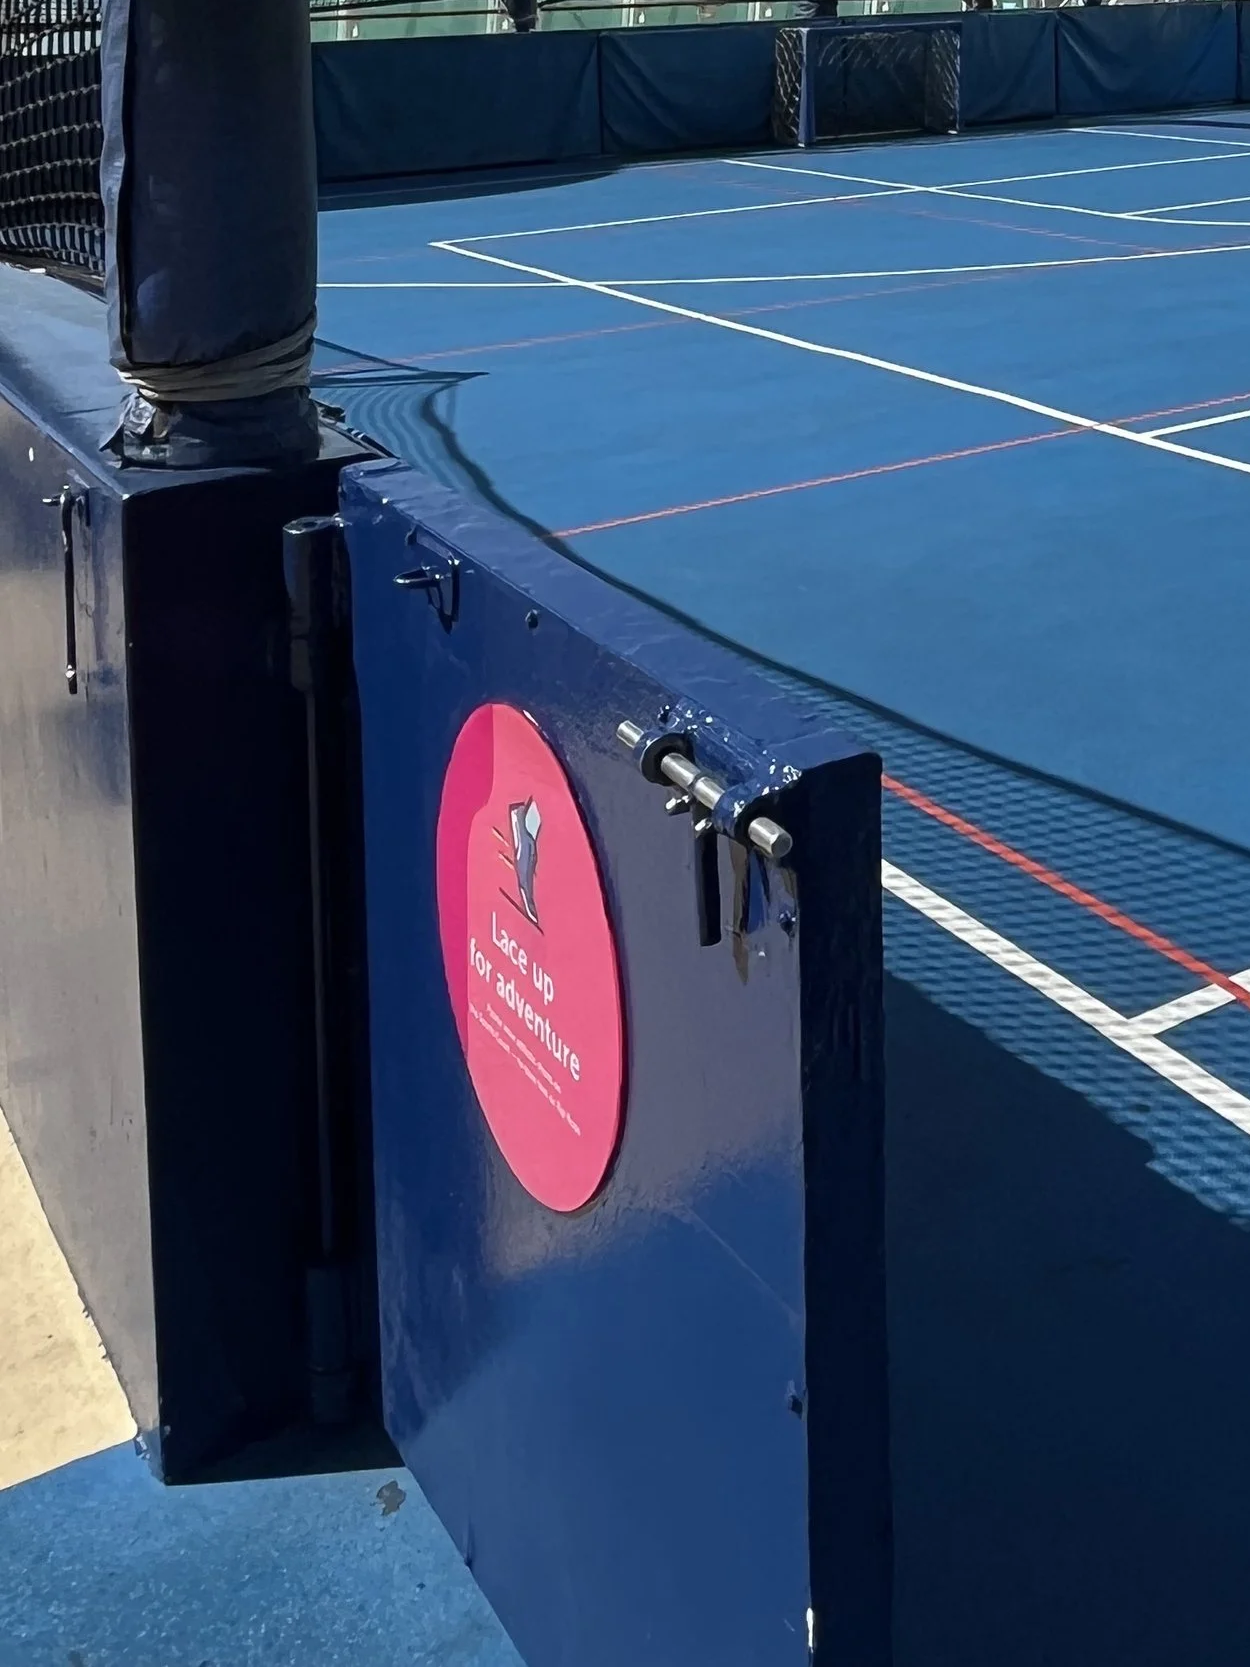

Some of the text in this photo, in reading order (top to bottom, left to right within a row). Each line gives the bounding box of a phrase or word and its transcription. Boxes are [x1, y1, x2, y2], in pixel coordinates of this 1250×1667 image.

[470, 938, 492, 982] for
[496, 972, 580, 1081] adventure
[491, 911, 554, 1005] Lace up
